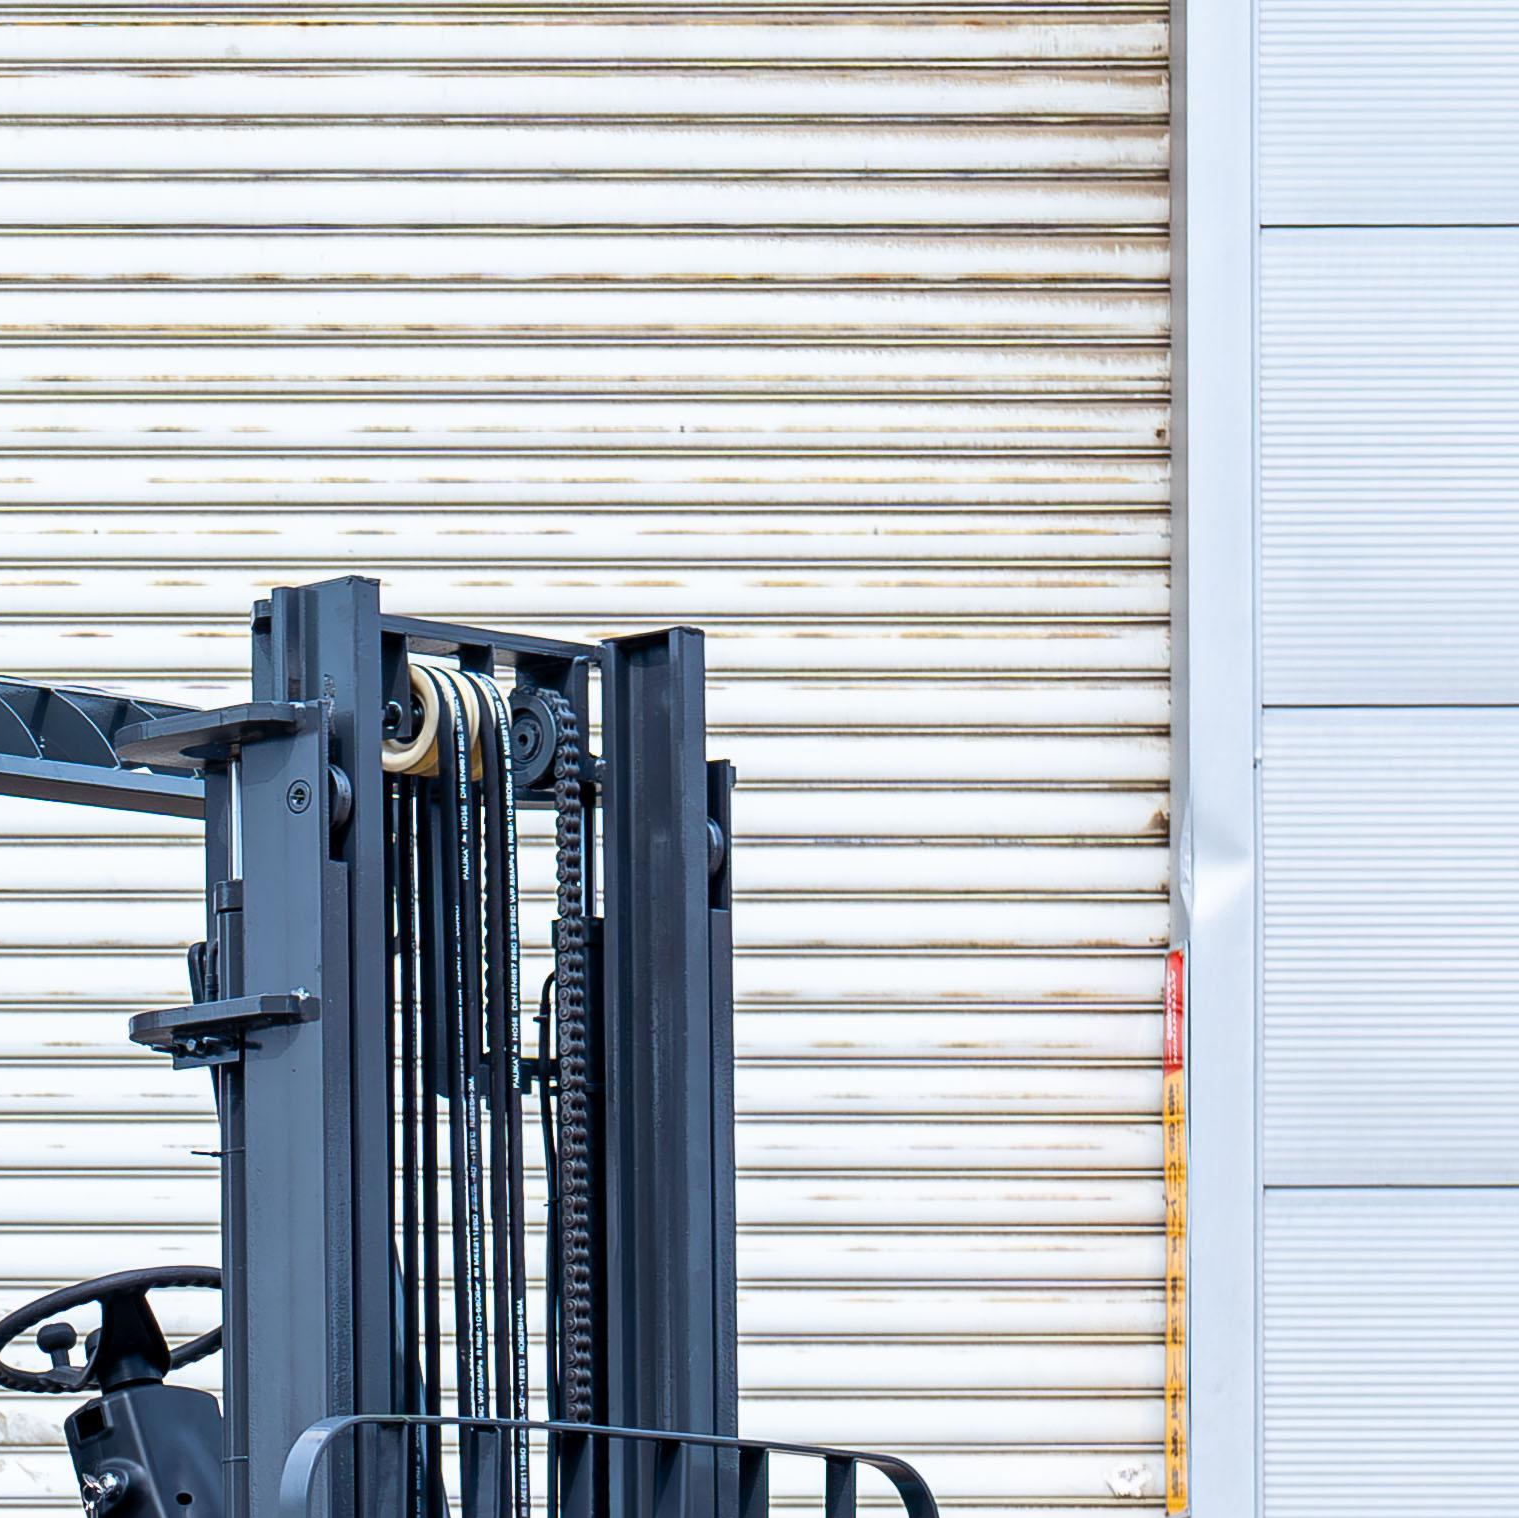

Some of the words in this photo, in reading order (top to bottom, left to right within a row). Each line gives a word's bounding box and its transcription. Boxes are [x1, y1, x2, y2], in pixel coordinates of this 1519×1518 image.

[459, 783, 467, 799] DIN
[460, 805, 468, 830] HOSE
[511, 995, 519, 1011] DIN
[511, 1017, 519, 1041] HOSE
